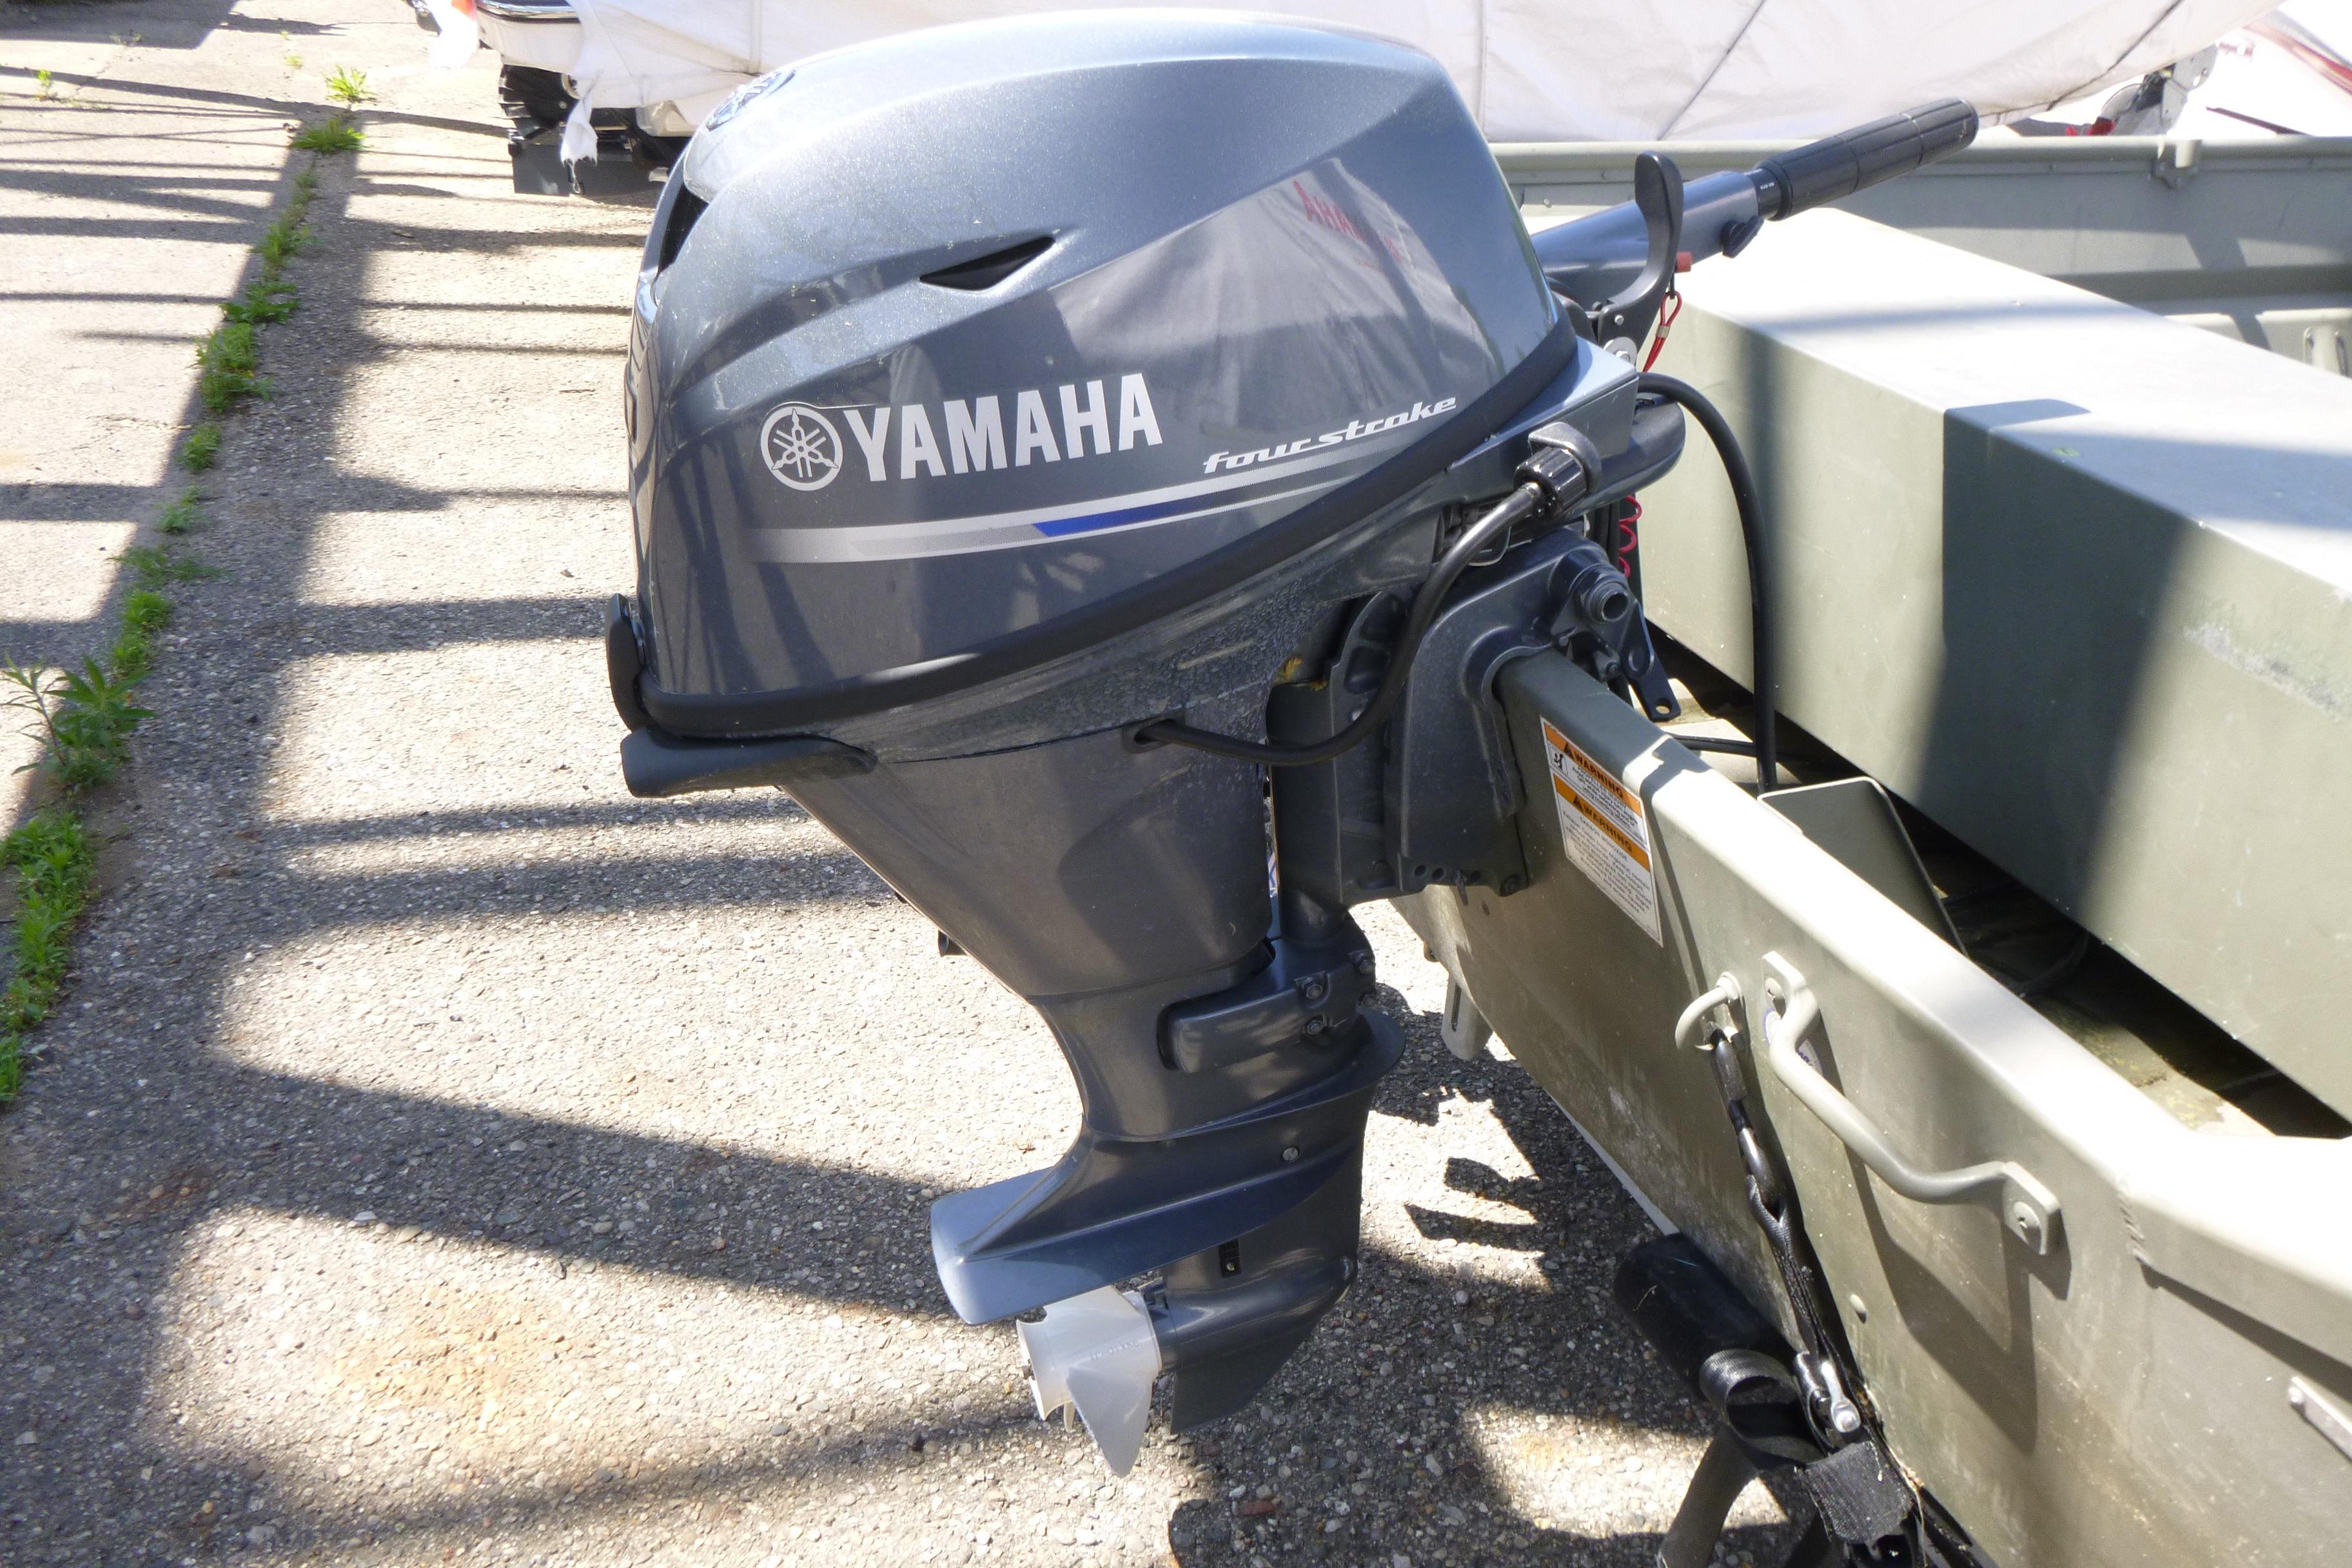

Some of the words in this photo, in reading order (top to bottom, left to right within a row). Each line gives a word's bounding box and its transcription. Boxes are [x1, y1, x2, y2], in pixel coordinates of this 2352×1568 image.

[843, 373, 1162, 482] YAMAHA
[1573, 753, 1623, 799] WARNING
[1583, 806, 1632, 853] WARNING
